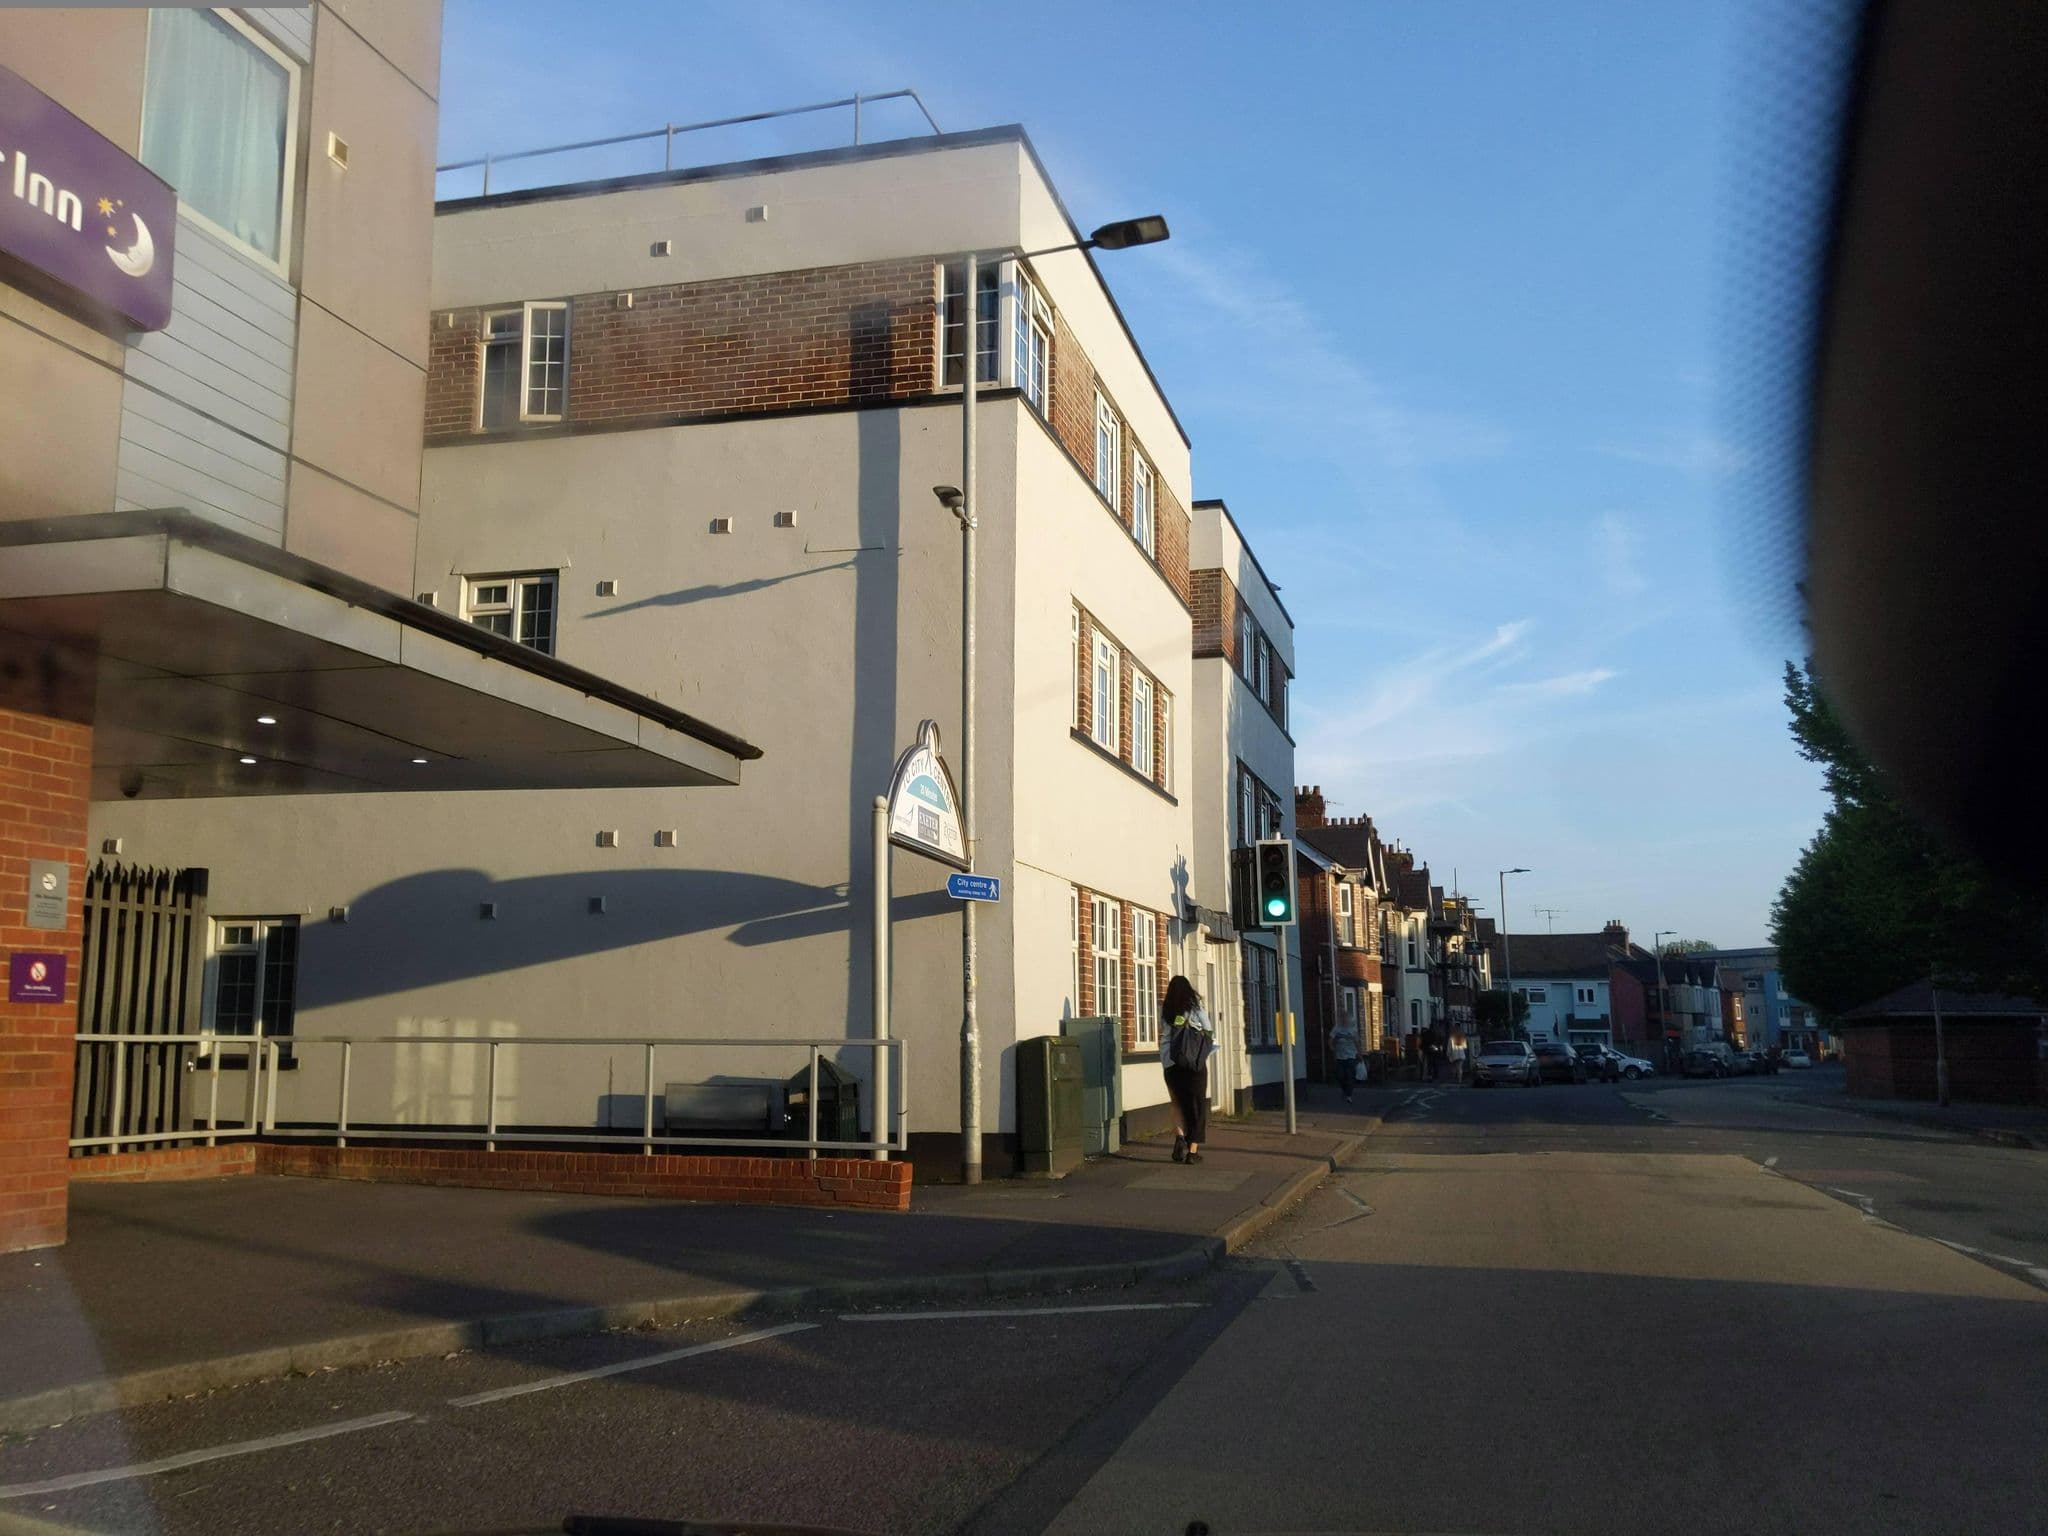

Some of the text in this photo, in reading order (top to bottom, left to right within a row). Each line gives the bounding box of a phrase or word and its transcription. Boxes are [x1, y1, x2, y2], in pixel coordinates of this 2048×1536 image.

[14, 151, 82, 232] Inn
[957, 878, 988, 889] City centre
